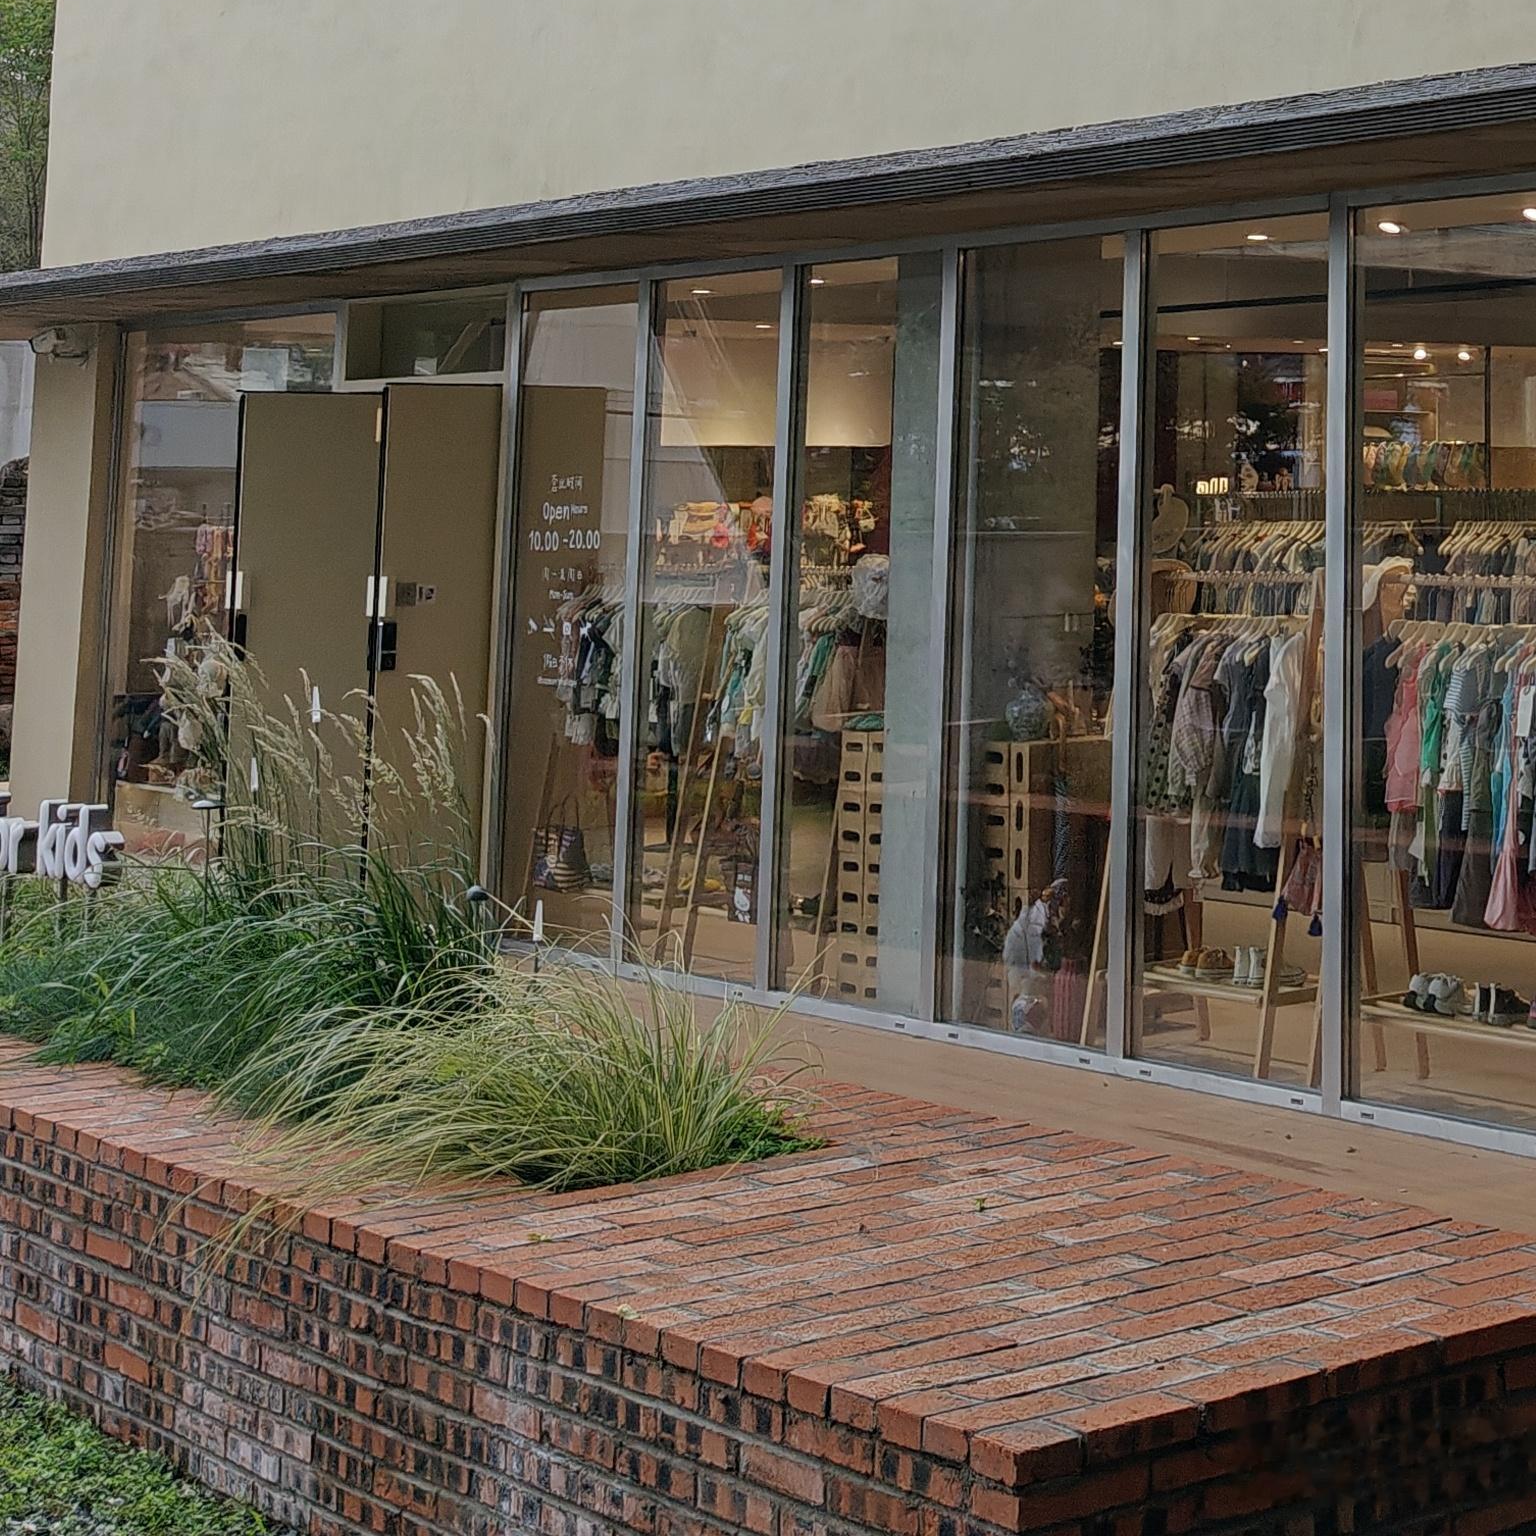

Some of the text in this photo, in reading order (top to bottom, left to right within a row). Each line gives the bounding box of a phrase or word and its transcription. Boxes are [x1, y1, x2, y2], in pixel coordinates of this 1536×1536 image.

[543, 502, 570, 526] Open
[529, 530, 559, 551] 10.00
[37, 799, 107, 889] kids
